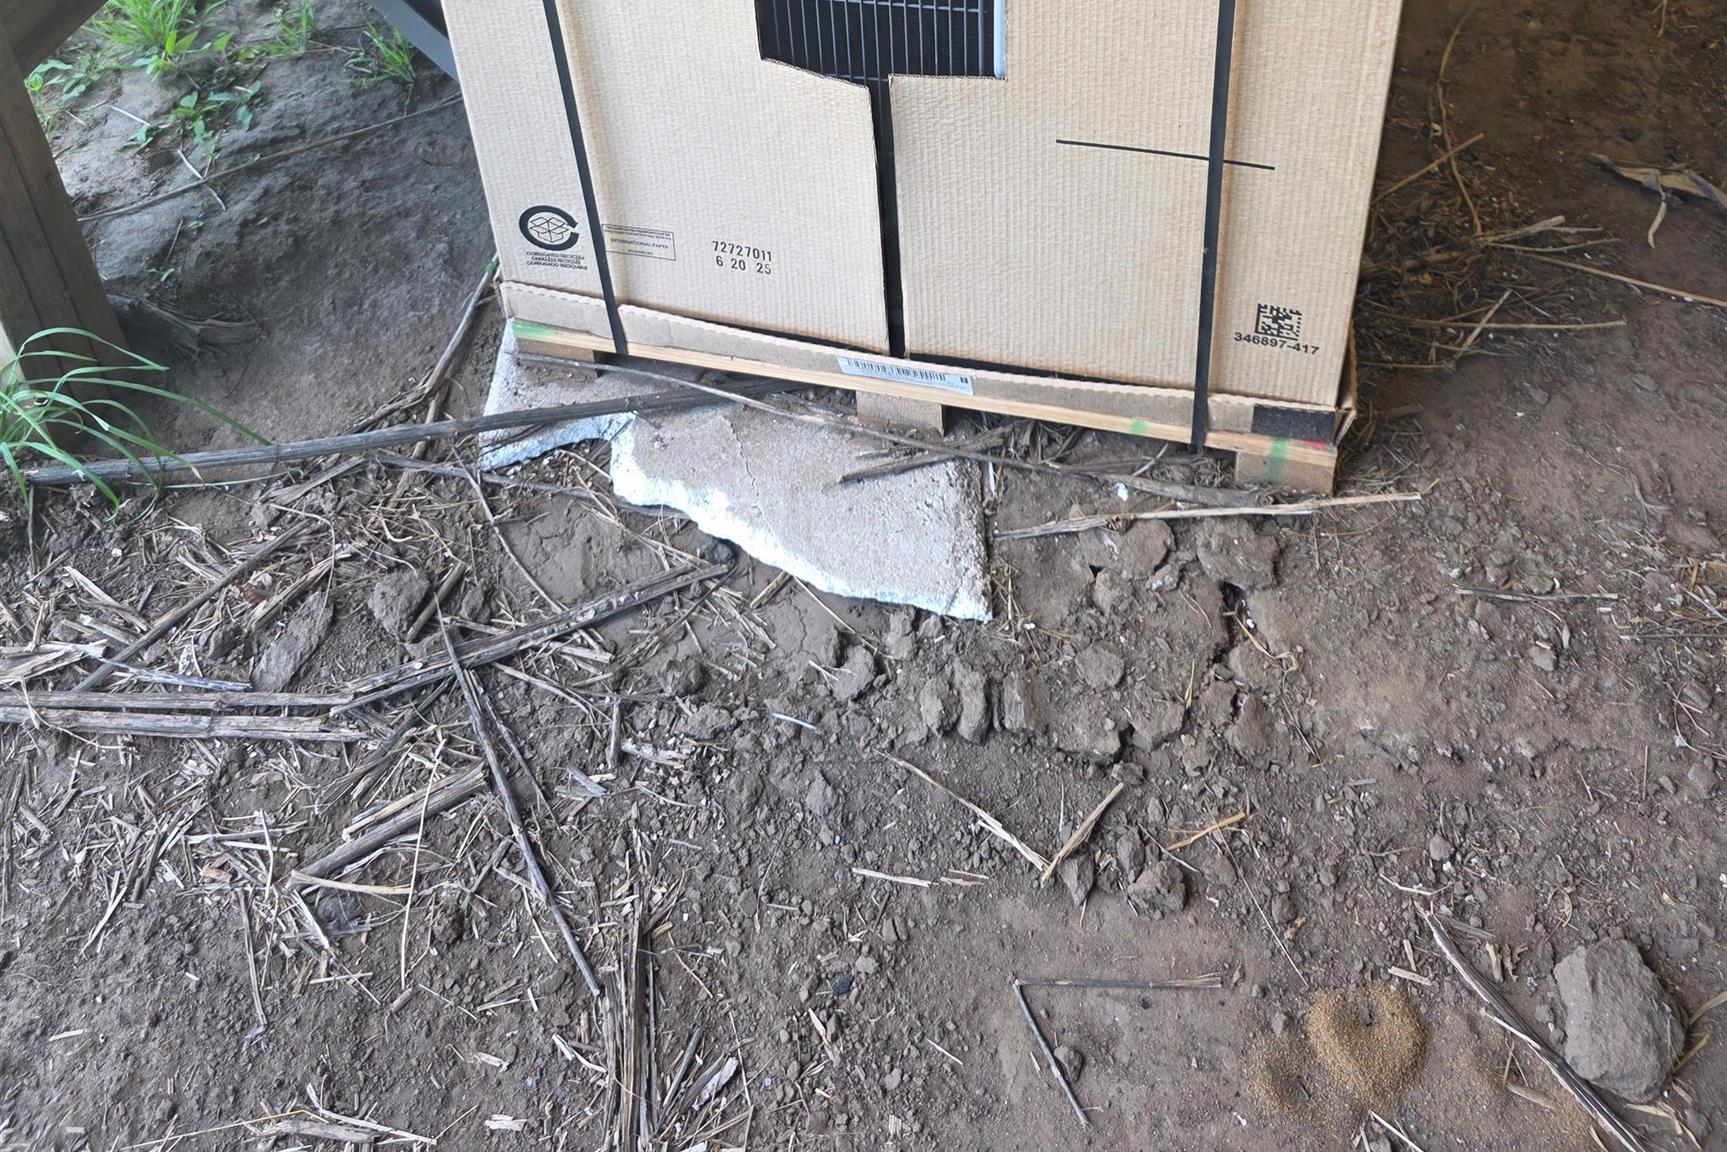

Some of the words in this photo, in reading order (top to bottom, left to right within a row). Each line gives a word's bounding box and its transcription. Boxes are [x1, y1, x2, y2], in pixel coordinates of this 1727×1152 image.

[712, 240, 772, 262] 72727011
[716, 255, 724, 267] 6
[731, 258, 746, 271] 20
[756, 262, 772, 275] 25
[1233, 331, 1320, 355] 346897-417
